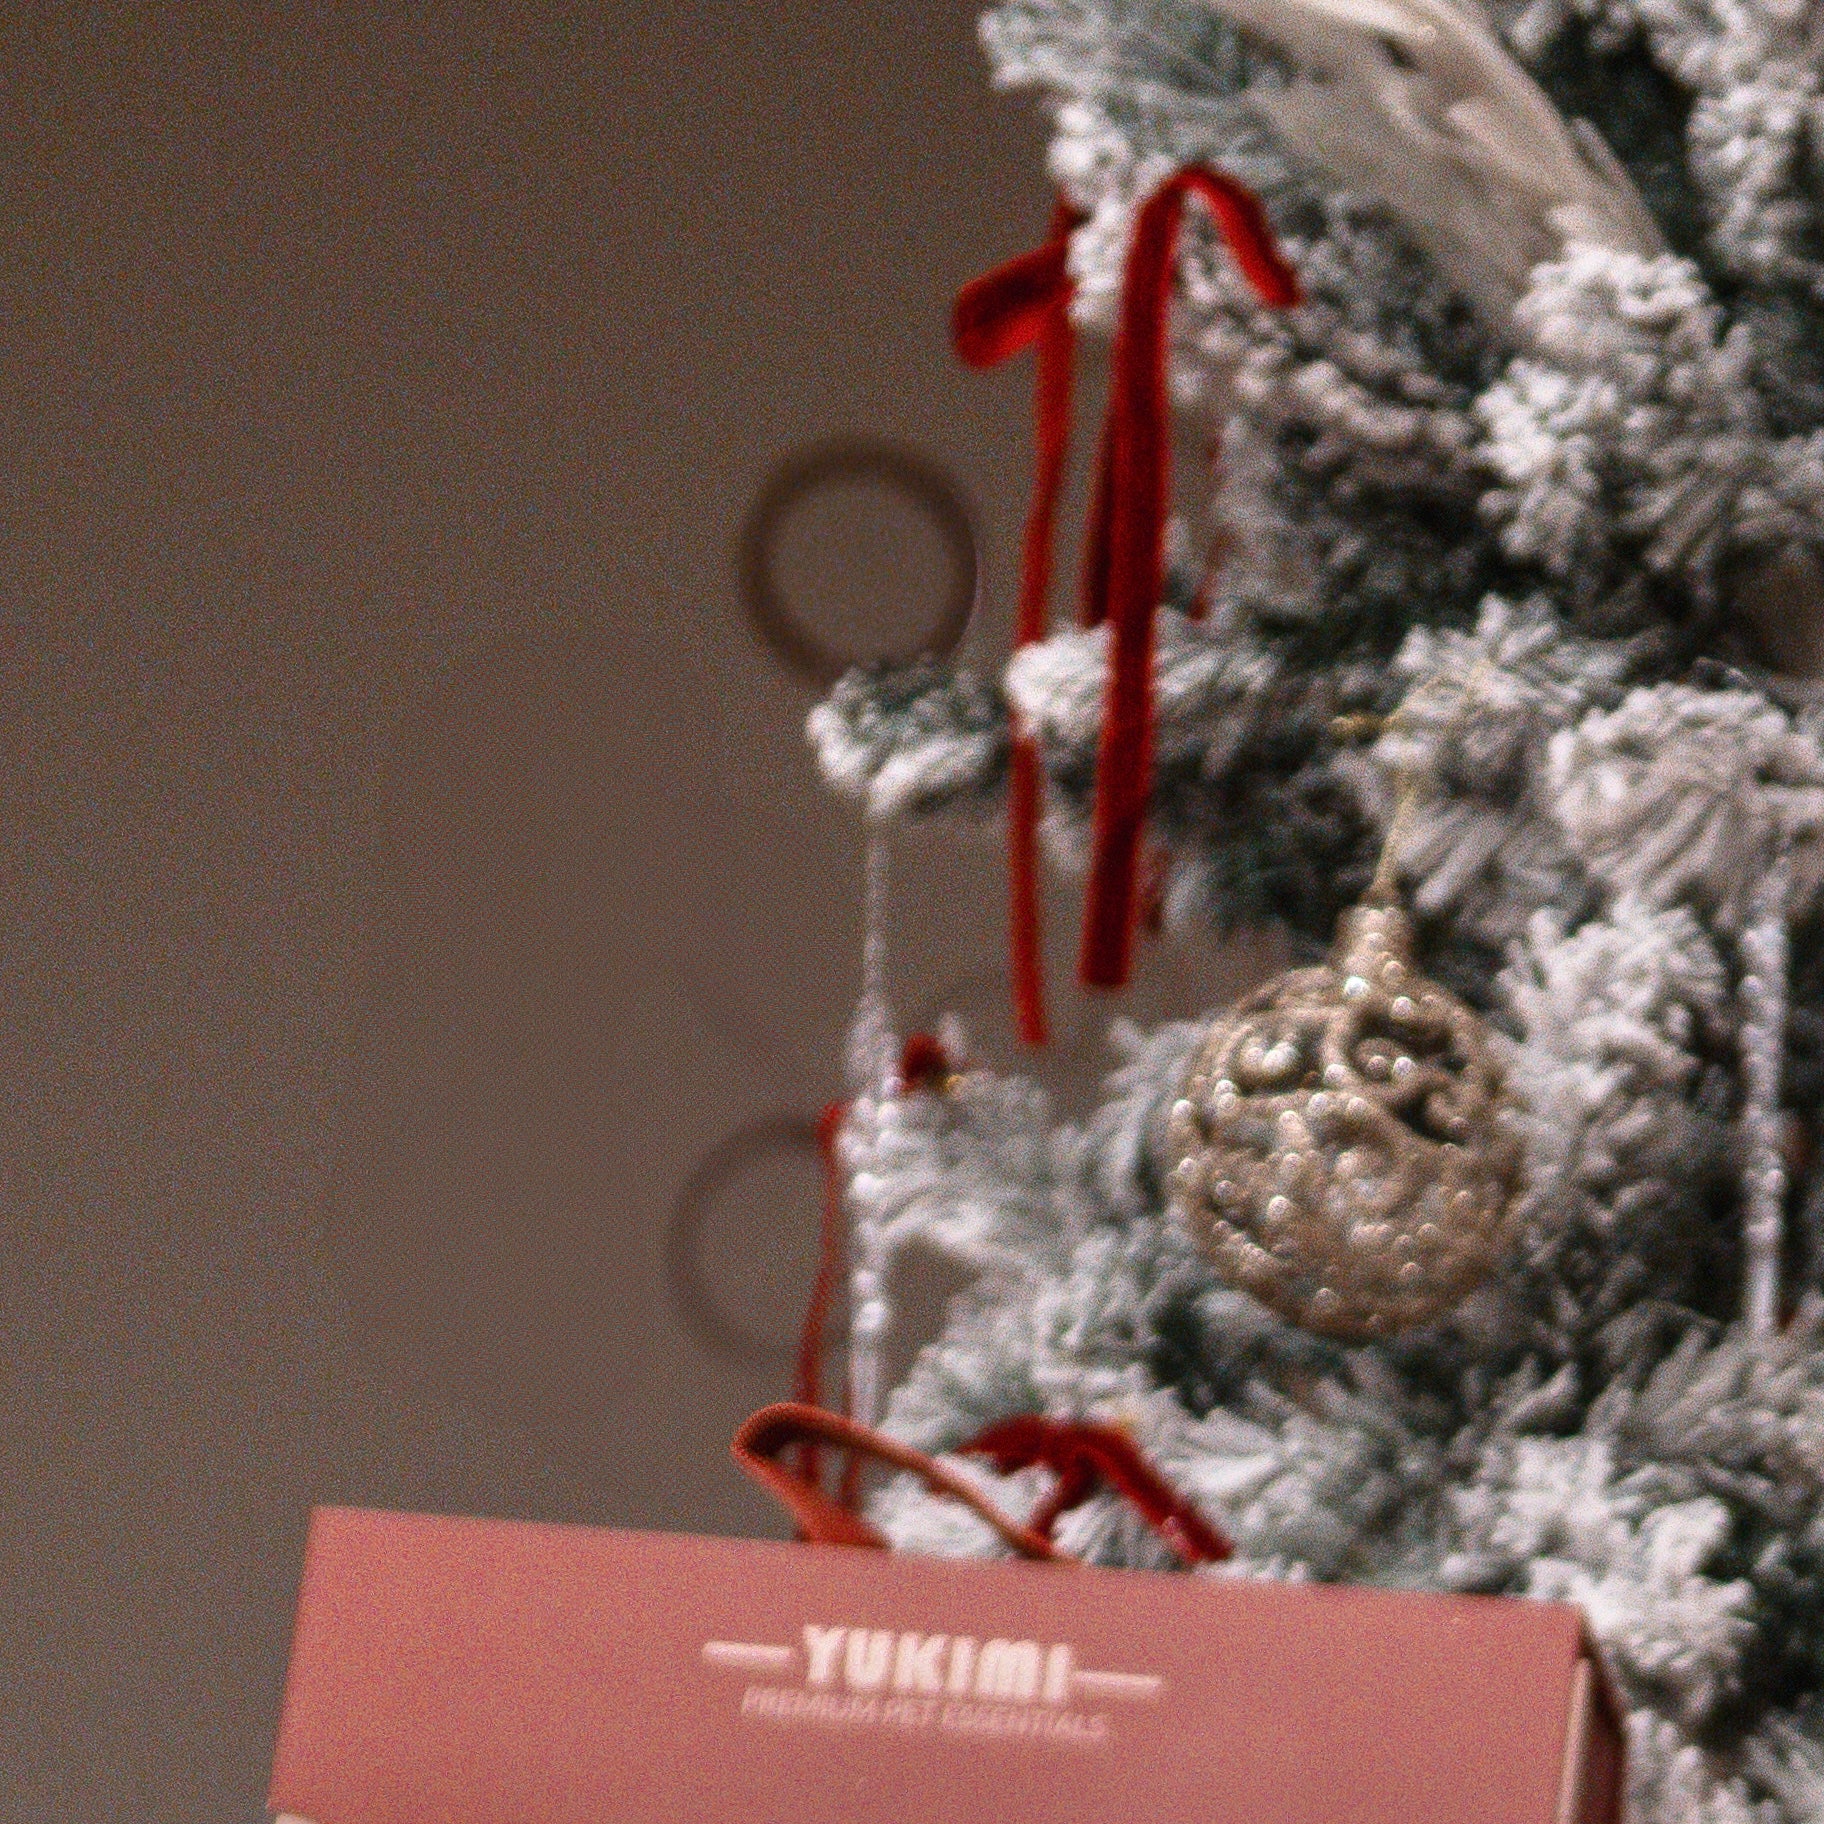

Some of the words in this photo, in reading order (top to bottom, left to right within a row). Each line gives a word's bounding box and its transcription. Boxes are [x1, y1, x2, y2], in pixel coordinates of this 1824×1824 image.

[804, 1624, 1073, 1703] YUKIMI
[741, 1686, 878, 1724] PREMIUM
[882, 1699, 934, 1727] PET
[942, 1702, 1109, 1740] ESSENTIALS
